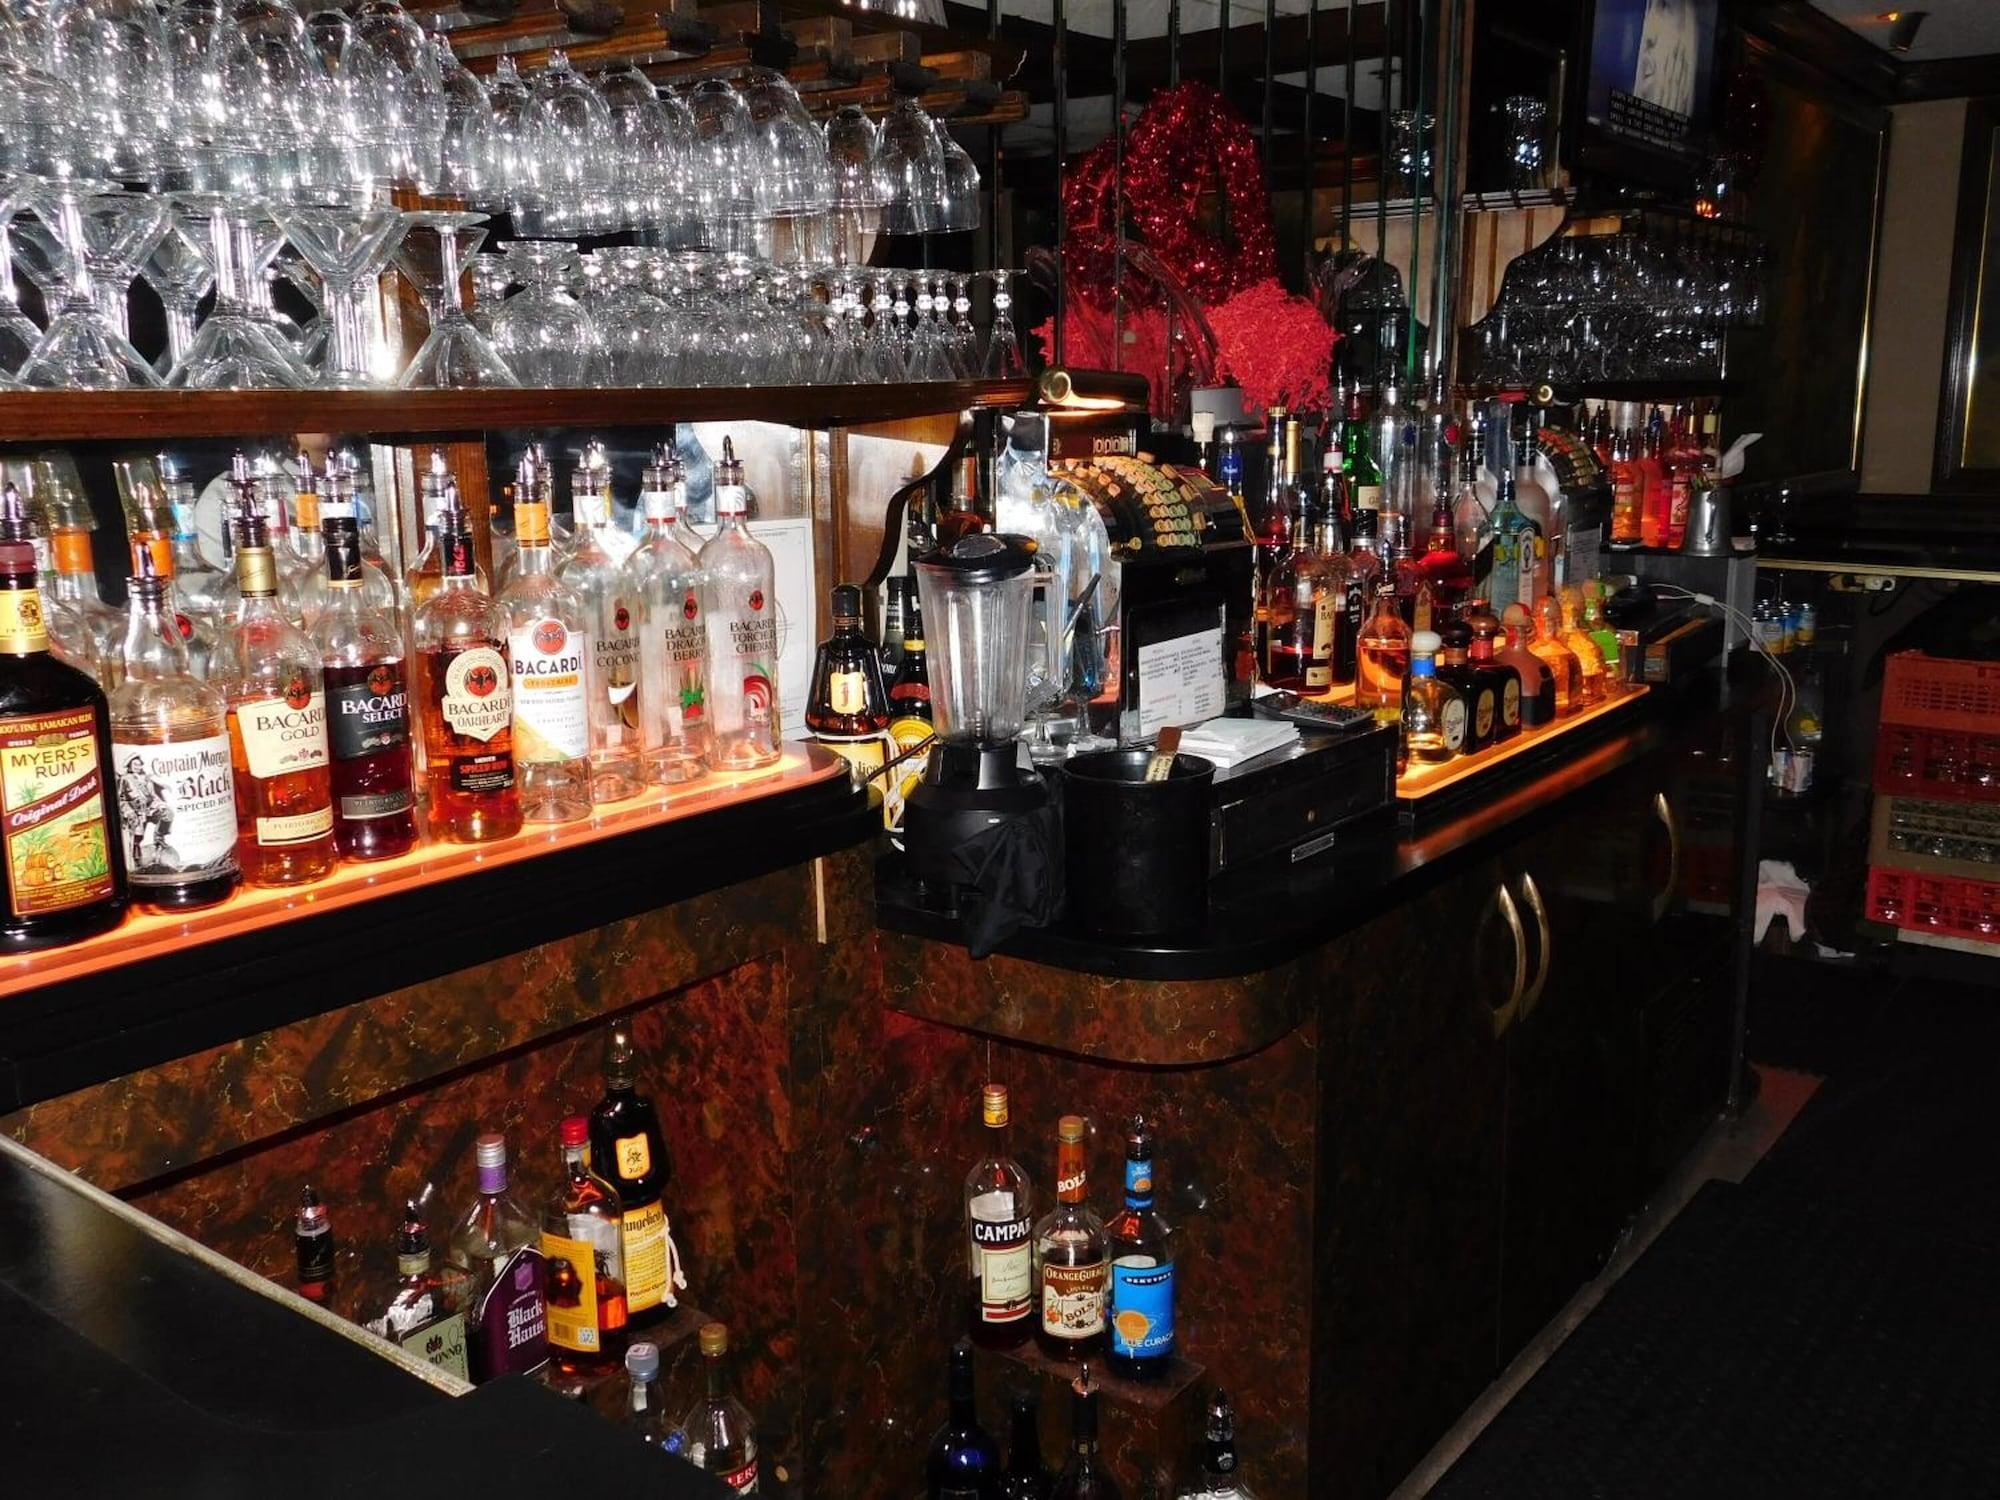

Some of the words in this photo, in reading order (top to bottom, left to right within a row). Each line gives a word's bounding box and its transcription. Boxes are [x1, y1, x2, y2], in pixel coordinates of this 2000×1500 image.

[361, 707, 404, 724] SELECT
[456, 709, 507, 728] OAKHEART
[280, 725, 321, 743] GOLD
[10, 743, 91, 769] MYERS'S
[151, 752, 199, 777] Captain
[35, 761, 77, 779] RUM
[175, 767, 232, 801] Black
[11, 792, 69, 826] Original
[66, 776, 98, 802] Dark
[176, 799, 217, 813] SPICED
[1057, 1169, 1087, 1193] BOLS
[506, 1299, 543, 1329] Black
[1065, 1300, 1095, 1323] BOLS
